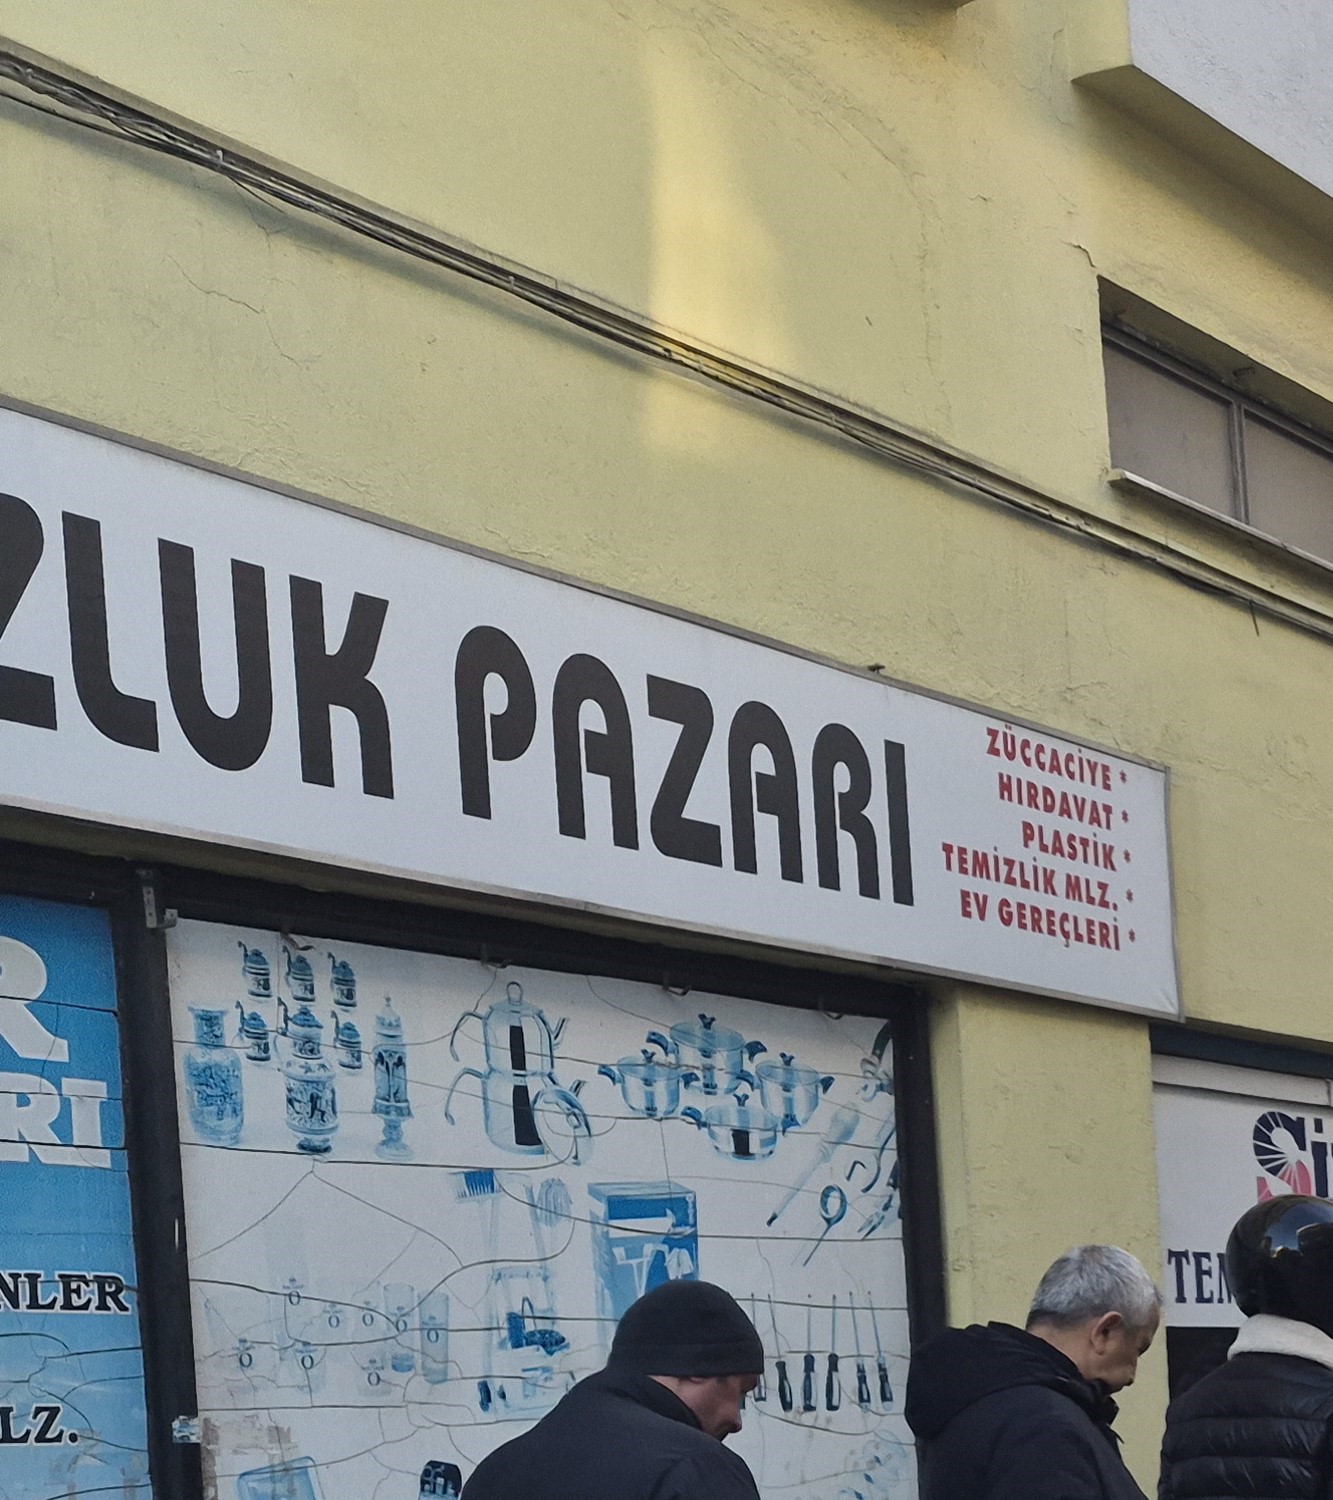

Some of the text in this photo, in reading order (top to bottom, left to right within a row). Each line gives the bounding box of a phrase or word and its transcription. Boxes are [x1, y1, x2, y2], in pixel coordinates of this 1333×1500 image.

[454, 625, 915, 907] PAZARI
[986, 723, 1112, 791] ZÜCCACİYE
[998, 772, 1113, 830] HIRDAVAT
[1021, 820, 1117, 871] PLASTİK
[941, 842, 1118, 912] TEMİZLİK MLZ.
[959, 889, 1120, 951] EV GEREÇLERİ
[0, 1406, 78, 1443] LZ.
